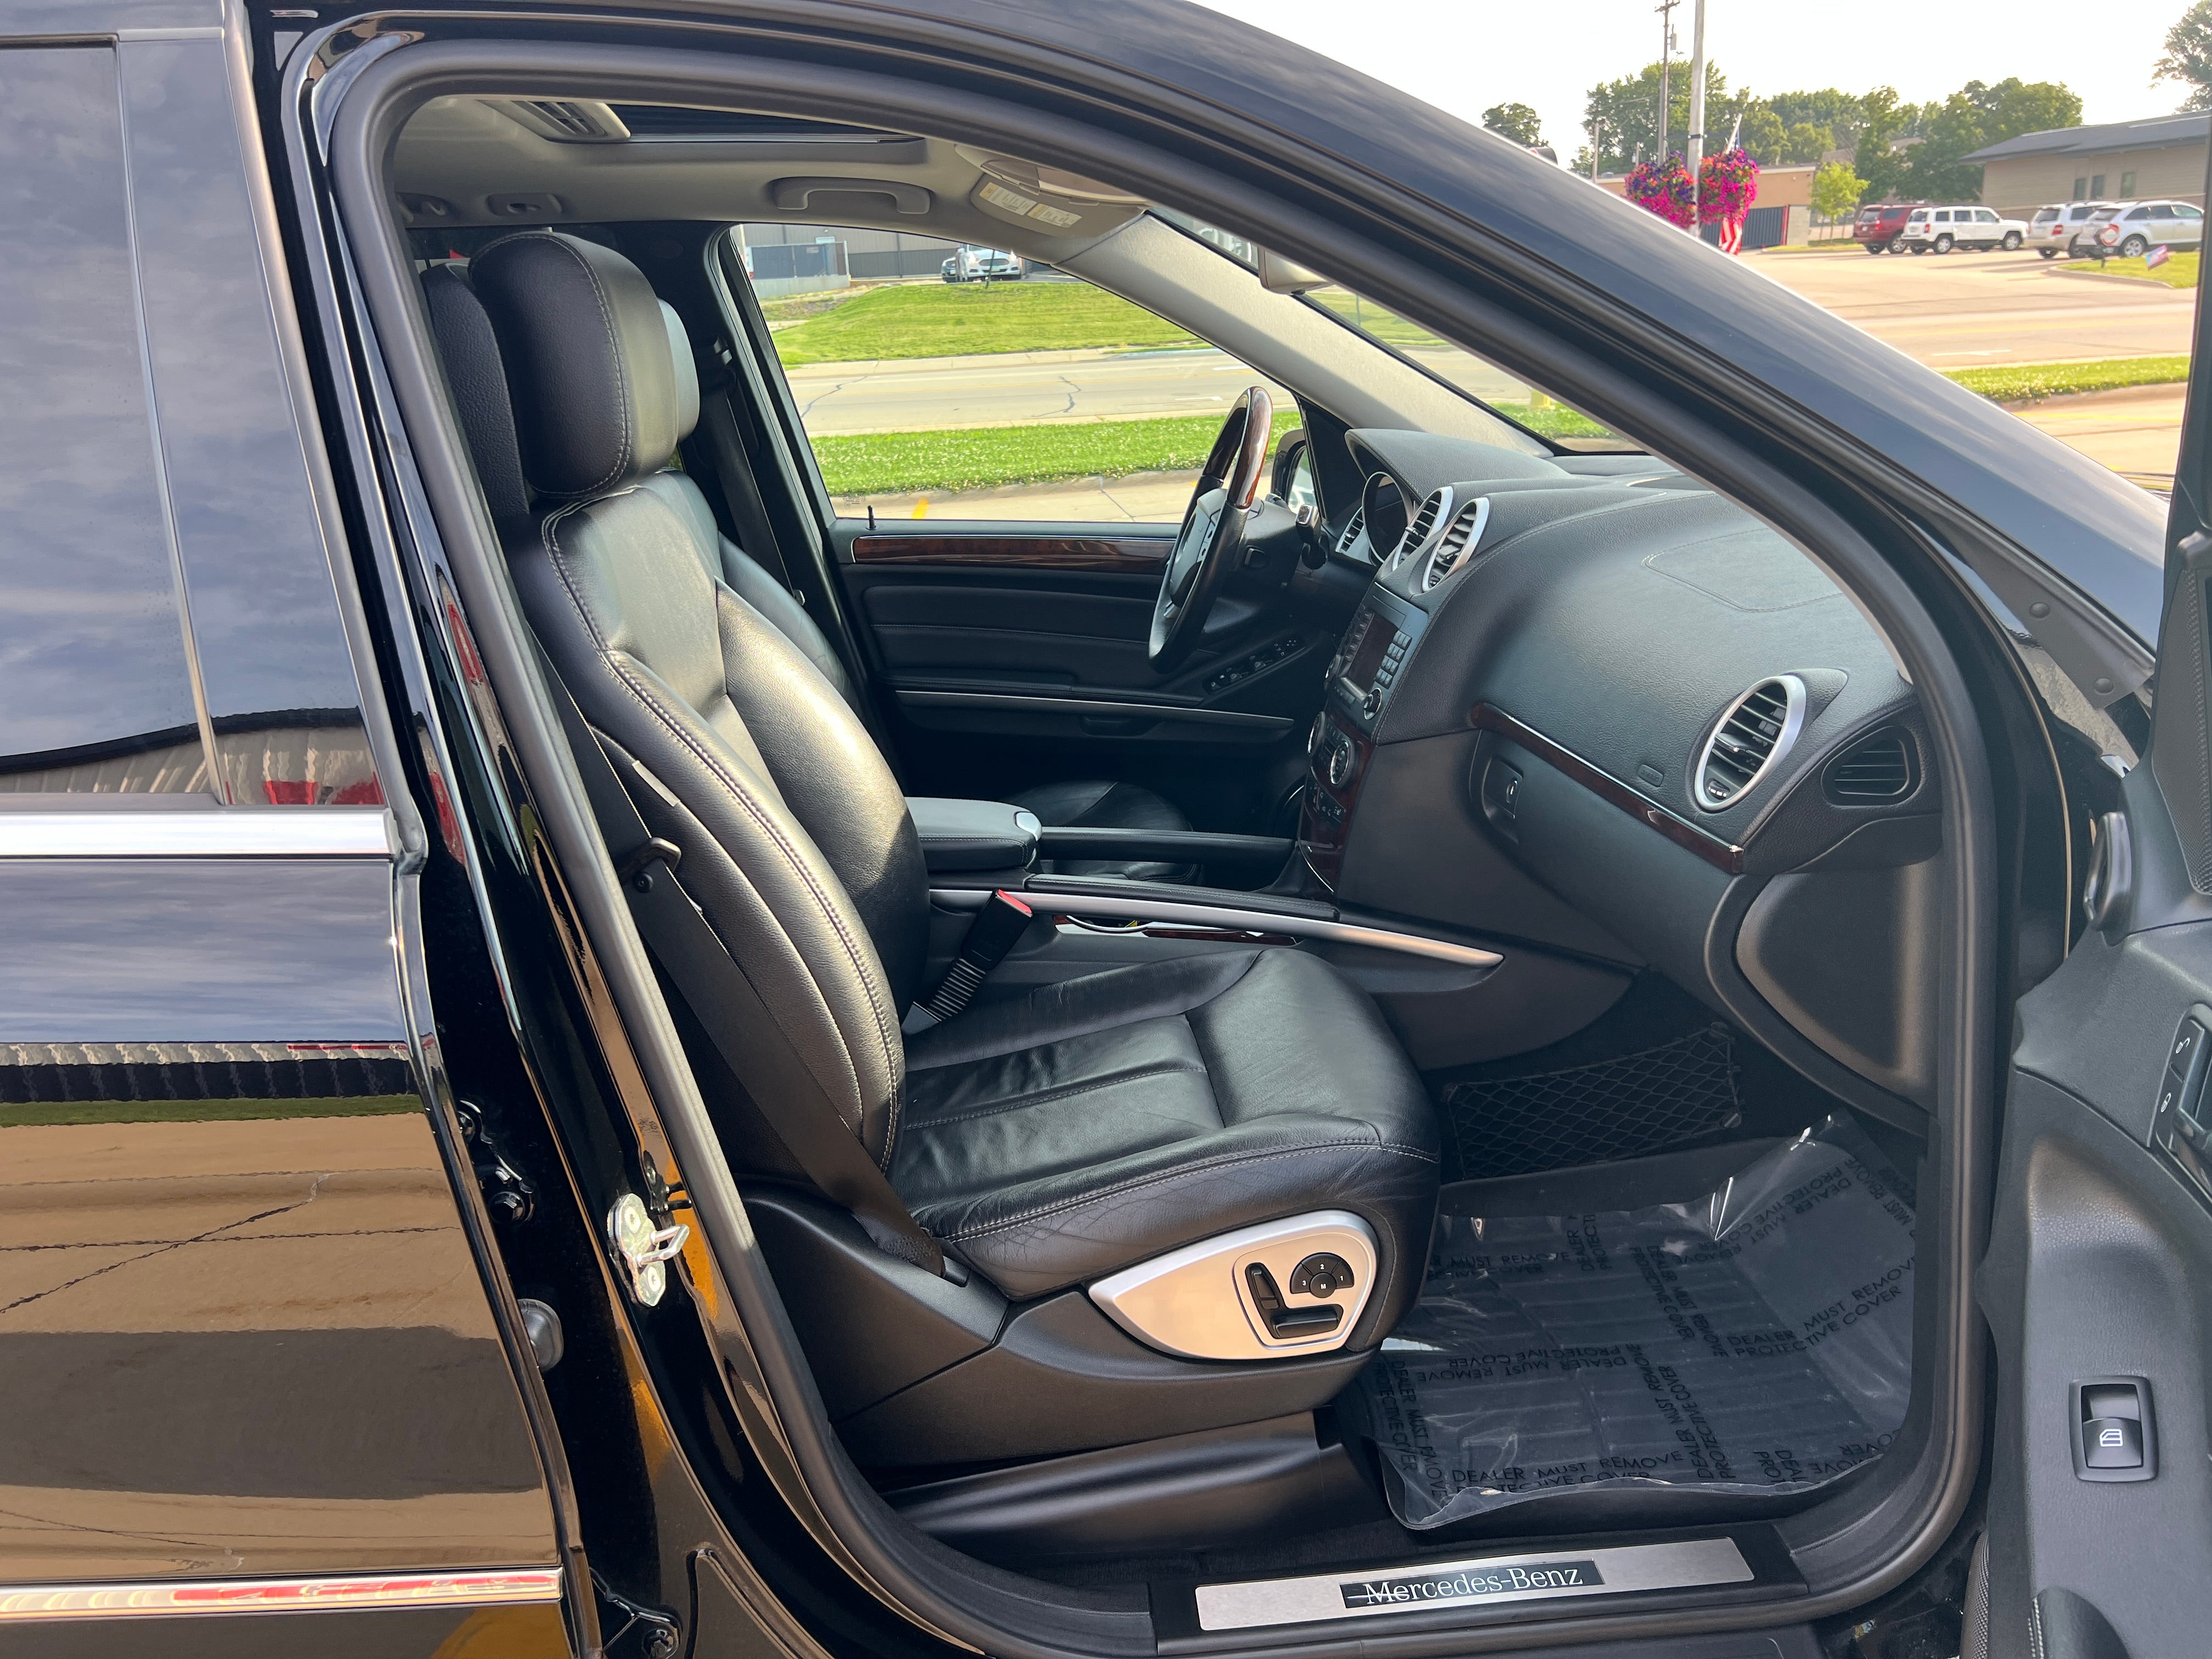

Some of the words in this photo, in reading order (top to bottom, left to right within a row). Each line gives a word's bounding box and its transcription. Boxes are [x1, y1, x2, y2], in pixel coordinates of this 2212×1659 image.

[1754, 1167, 1843, 1223] PROTECTIVE
[1795, 1177, 1852, 1215] DEALER
[1584, 1214, 1612, 1269] PROTECTI
[1751, 1214, 1786, 1246] MUST
[1451, 1255, 1491, 1268] MUST
[1567, 1229, 1594, 1272] DEALER
[1727, 1330, 1798, 1345] DEALER
[1803, 1300, 1847, 1331] MUST
[1735, 1321, 1841, 1357] PROTECTIVE
[1842, 1285, 1903, 1327] COVER
[1448, 1354, 1511, 1368] COVER
[1505, 1361, 1549, 1376] MUST
[1515, 1345, 1622, 1361] PROTECTIVE
[1561, 1356, 1627, 1370] DEALER
[1417, 1367, 1494, 1383] REMOVE
[1658, 1365, 1691, 1400] COVER
[1373, 1362, 1404, 1431] PROTECTIVE
[1391, 1361, 1417, 1401] DEALER
[1407, 1409, 1429, 1440] MUST
[1655, 1397, 1684, 1425] MUST
[1676, 1428, 1714, 1479] DEALER
[1682, 1401, 1736, 1479] PROTECTIVE
[1839, 1428, 1899, 1458] OVER
[1452, 1467, 1524, 1482] DEALER
[1536, 1462, 1587, 1479] MUST
[1599, 1450, 1684, 1470] REMOVE
[1363, 1567, 1583, 1605] Mercedes-Benz
